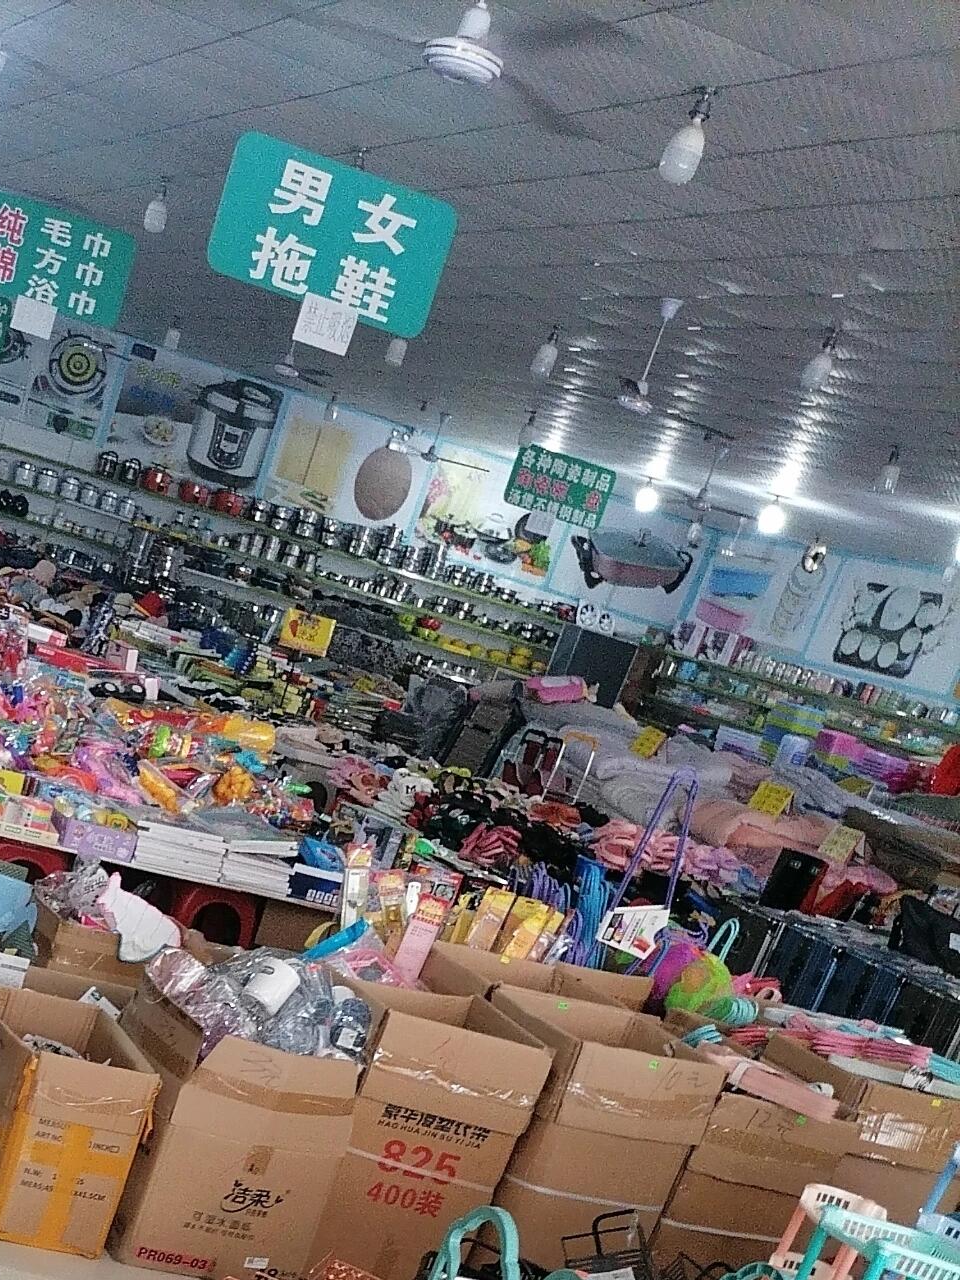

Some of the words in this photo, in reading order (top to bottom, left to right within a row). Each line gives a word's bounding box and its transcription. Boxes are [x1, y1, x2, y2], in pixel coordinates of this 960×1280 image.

[268, 158, 418, 256] 男女
[40, 217, 113, 260] 毛巾
[32, 246, 105, 288] 方巾
[249, 226, 397, 324] 拖鞋
[24, 274, 98, 317] 浴巾
[521, 449, 611, 493] 各种陶瓷制品
[377, 1119, 399, 1130] HAO
[400, 1124, 420, 1137] HUA
[377, 1139, 462, 1185] 825
[222, 1184, 282, 1212] 洁柔
[367, 1181, 446, 1218] 400装
[136, 1247, 208, 1271] PR069-03
